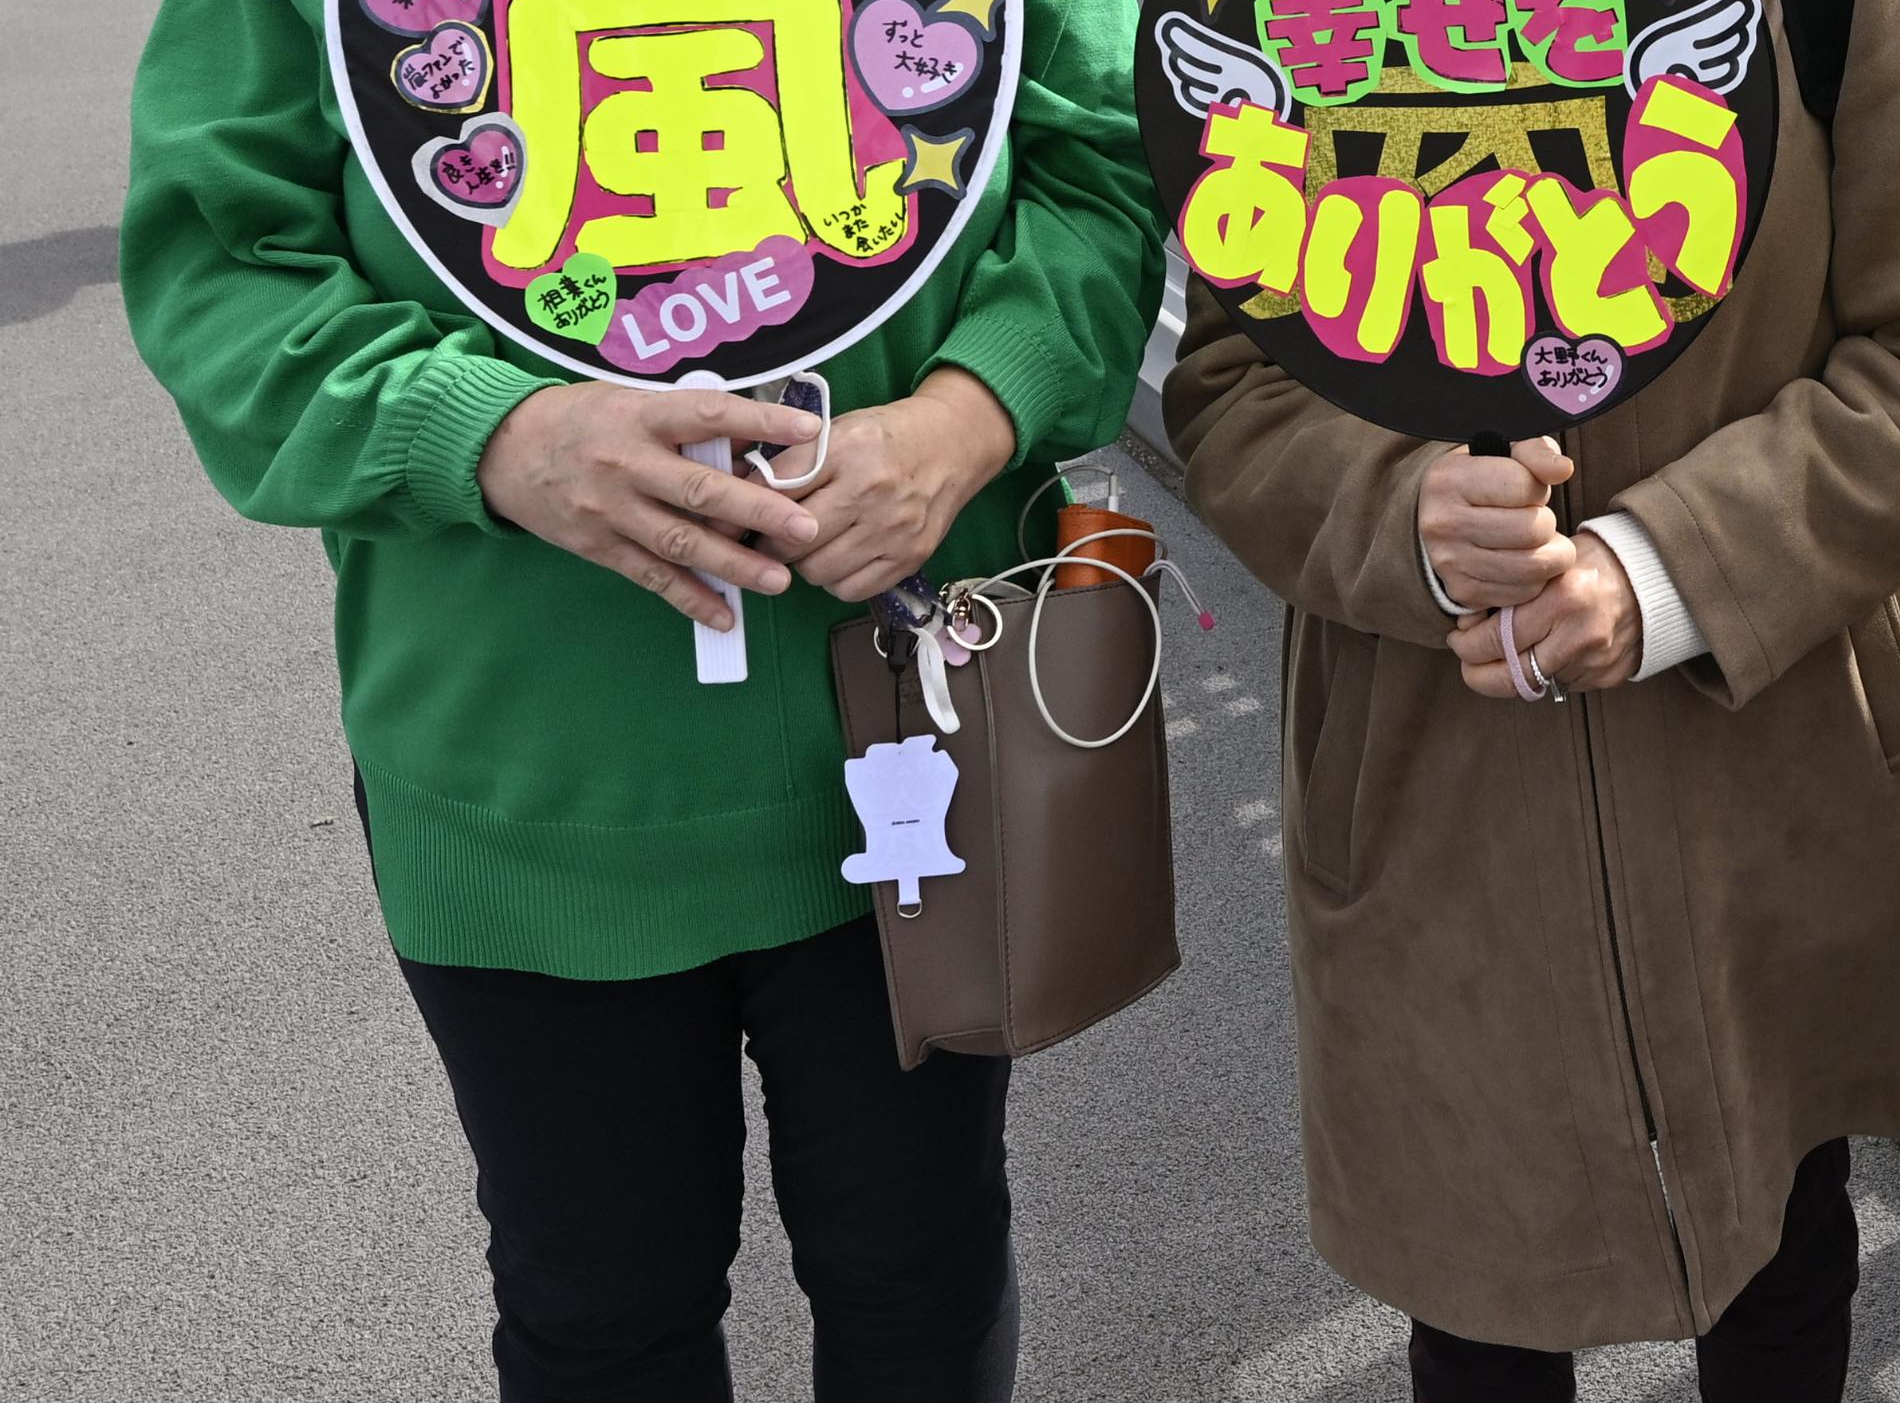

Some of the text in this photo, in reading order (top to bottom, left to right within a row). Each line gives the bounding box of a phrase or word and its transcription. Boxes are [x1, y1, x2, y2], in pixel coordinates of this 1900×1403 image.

[881, 20, 925, 48] ずっと
[894, 51, 958, 84] 大好き
[823, 203, 867, 227] いつか
[842, 218, 869, 239] また
[1182, 78, 1740, 370] ありがとう
[553, 289, 610, 330] ありがとう
[621, 256, 792, 361] LOVE
[1534, 346, 1608, 367] 大野くん
[1537, 366, 1608, 388] ありがとう
